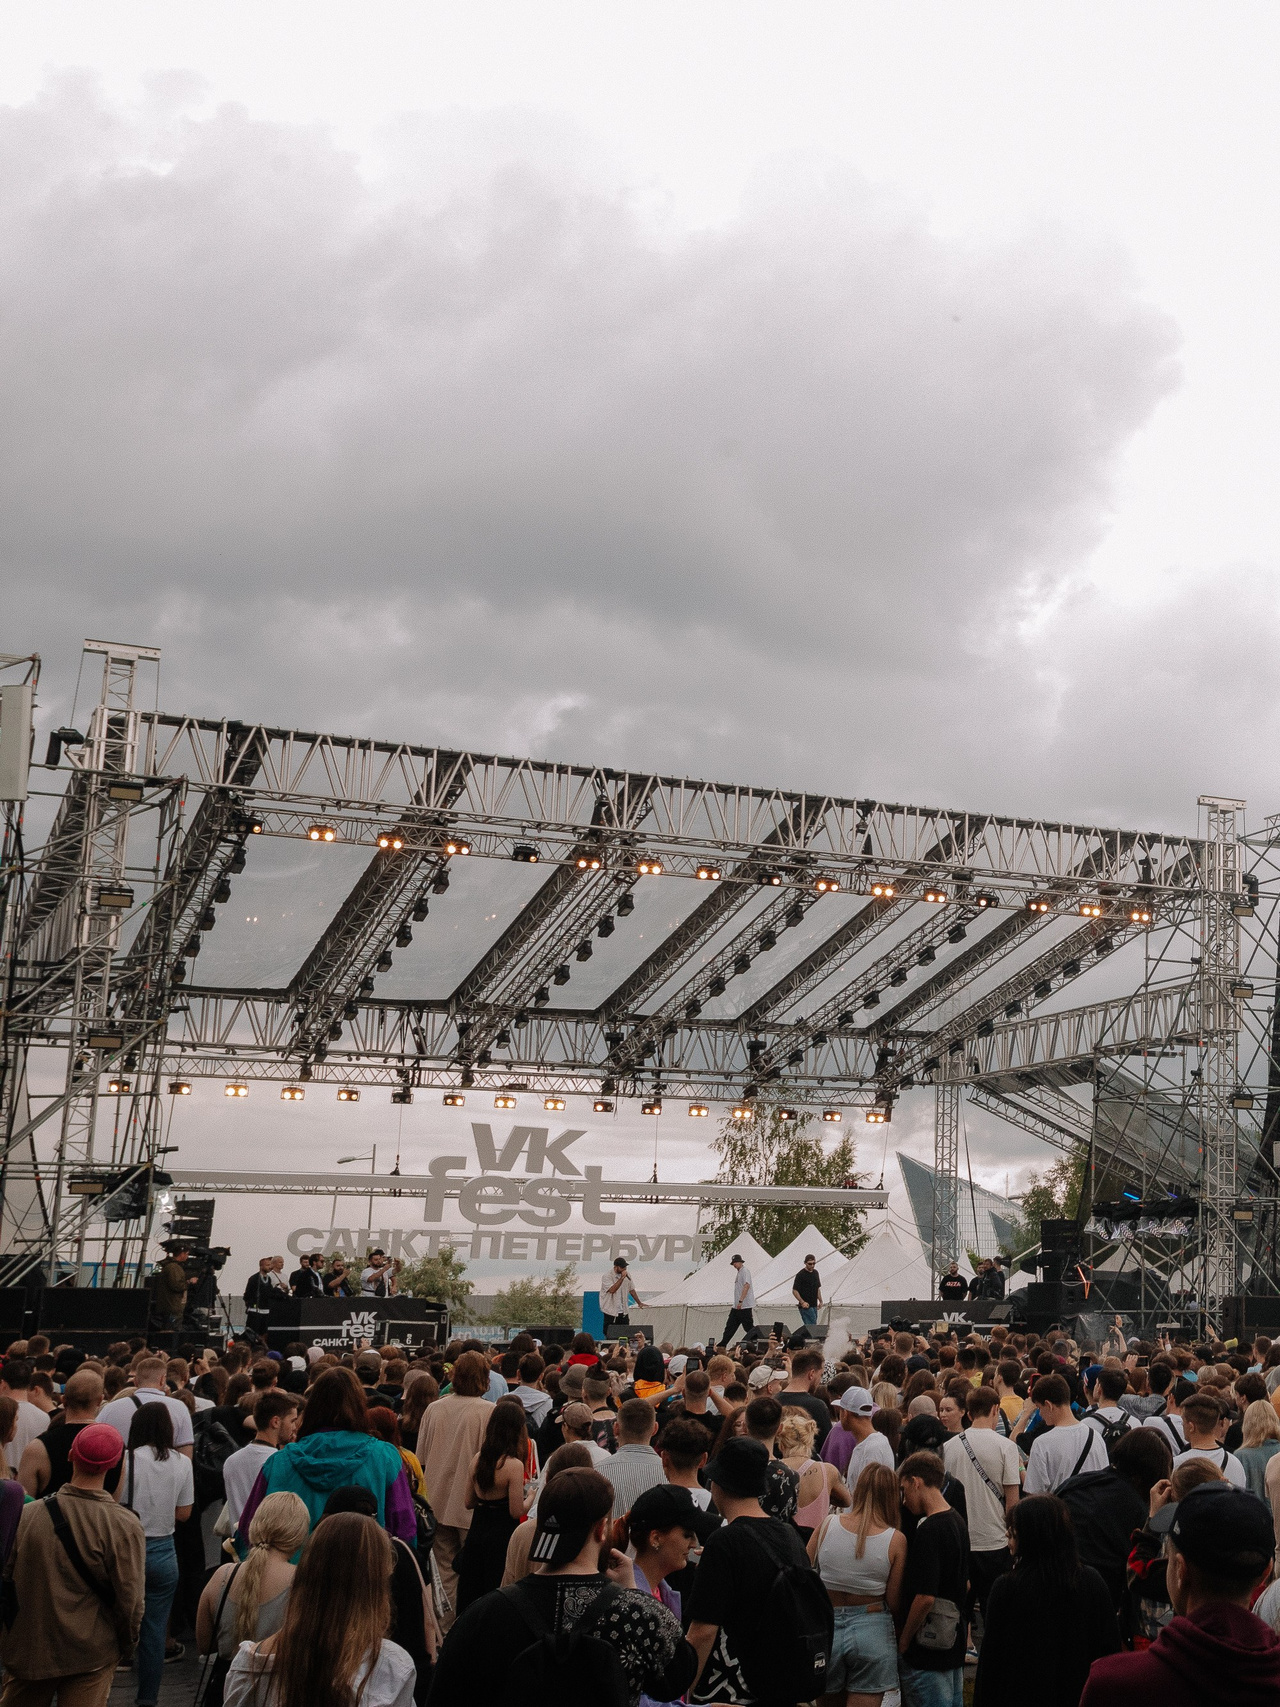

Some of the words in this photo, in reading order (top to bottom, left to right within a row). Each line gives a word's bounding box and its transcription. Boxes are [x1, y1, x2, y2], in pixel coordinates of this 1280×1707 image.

[471, 1122, 588, 1177] VK
[424, 1155, 616, 1227] fest
[286, 1227, 716, 1262] САНКТ-ПЕТЕРБУРГ
[341, 1319, 377, 1338] fes
[350, 1312, 378, 1324] VK
[943, 1312, 967, 1323] VK
